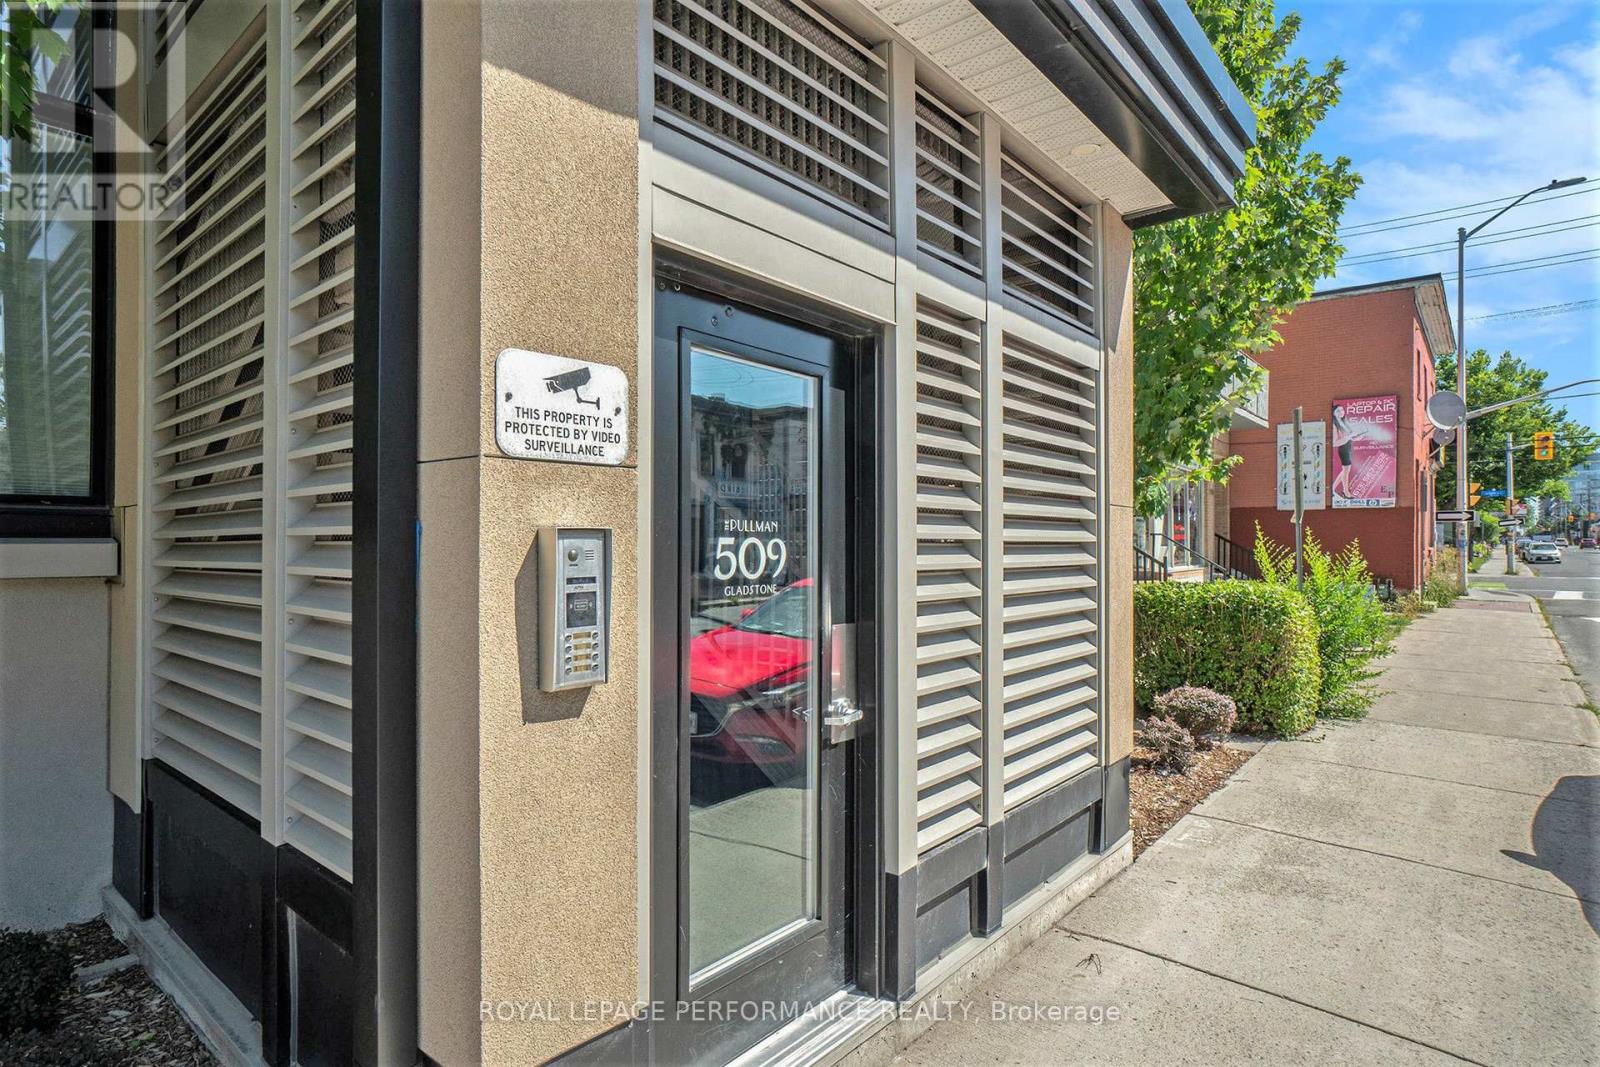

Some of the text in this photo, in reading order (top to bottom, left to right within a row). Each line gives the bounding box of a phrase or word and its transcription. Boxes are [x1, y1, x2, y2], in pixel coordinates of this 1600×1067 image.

[1346, 402, 1396, 415] REPAIR
[515, 406, 613, 429] THIS PROPERTY IS
[1349, 414, 1393, 424] SALES
[505, 421, 620, 444] PROTECTED BY VIDEO
[524, 438, 605, 457] SURVEILLANCE
[730, 519, 779, 532] PULLMAN
[714, 536, 787, 580] 509
[724, 584, 777, 597] GLADSTONE
